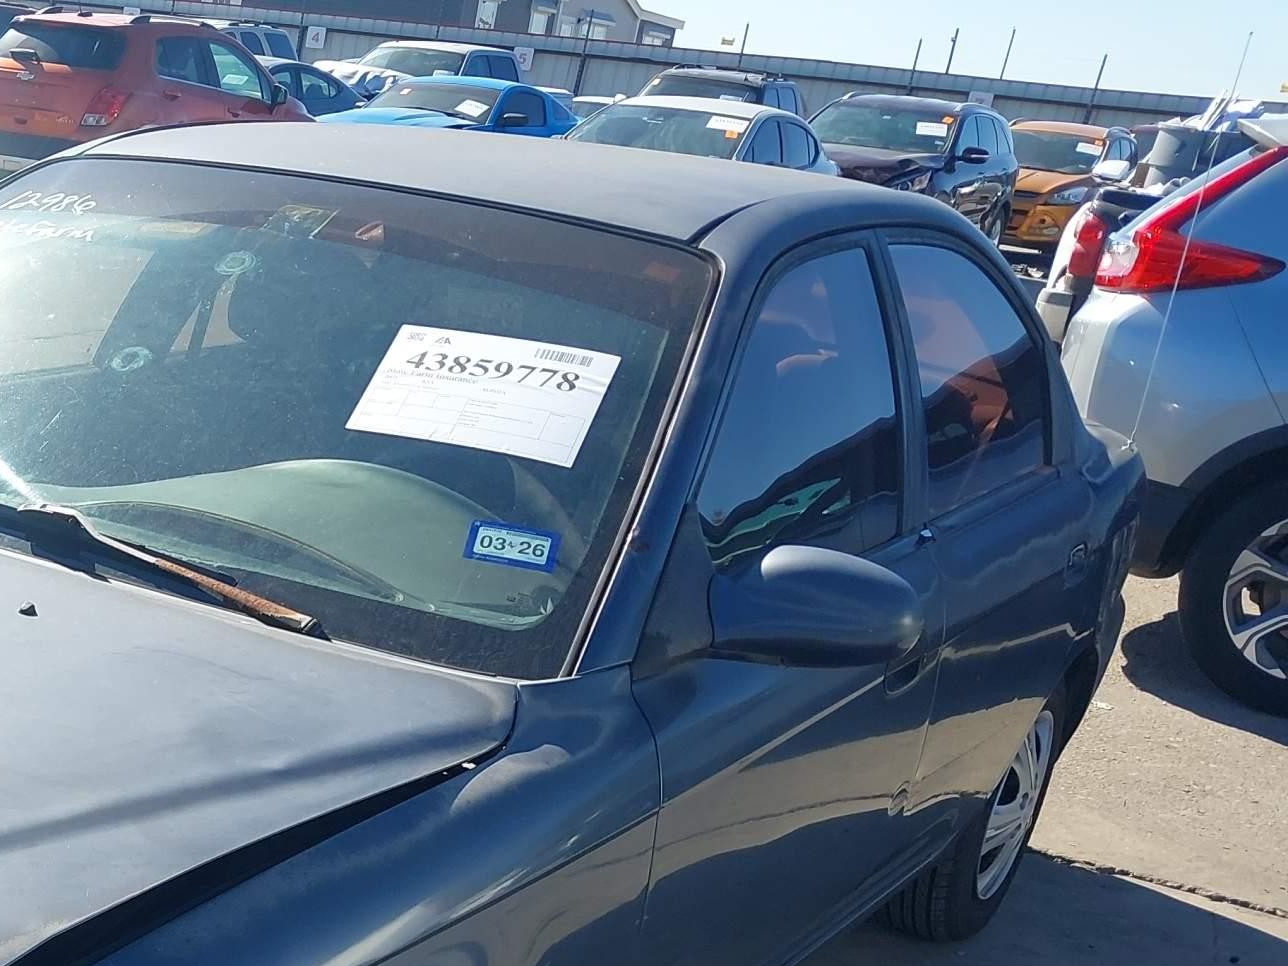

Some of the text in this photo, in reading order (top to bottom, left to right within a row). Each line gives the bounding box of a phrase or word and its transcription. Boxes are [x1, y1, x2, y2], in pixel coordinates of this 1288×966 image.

[311, 31, 320, 43] 4
[518, 53, 529, 65] 5
[406, 350, 580, 392] 43859778
[480, 535, 507, 551] 03
[517, 541, 546, 557] 26
